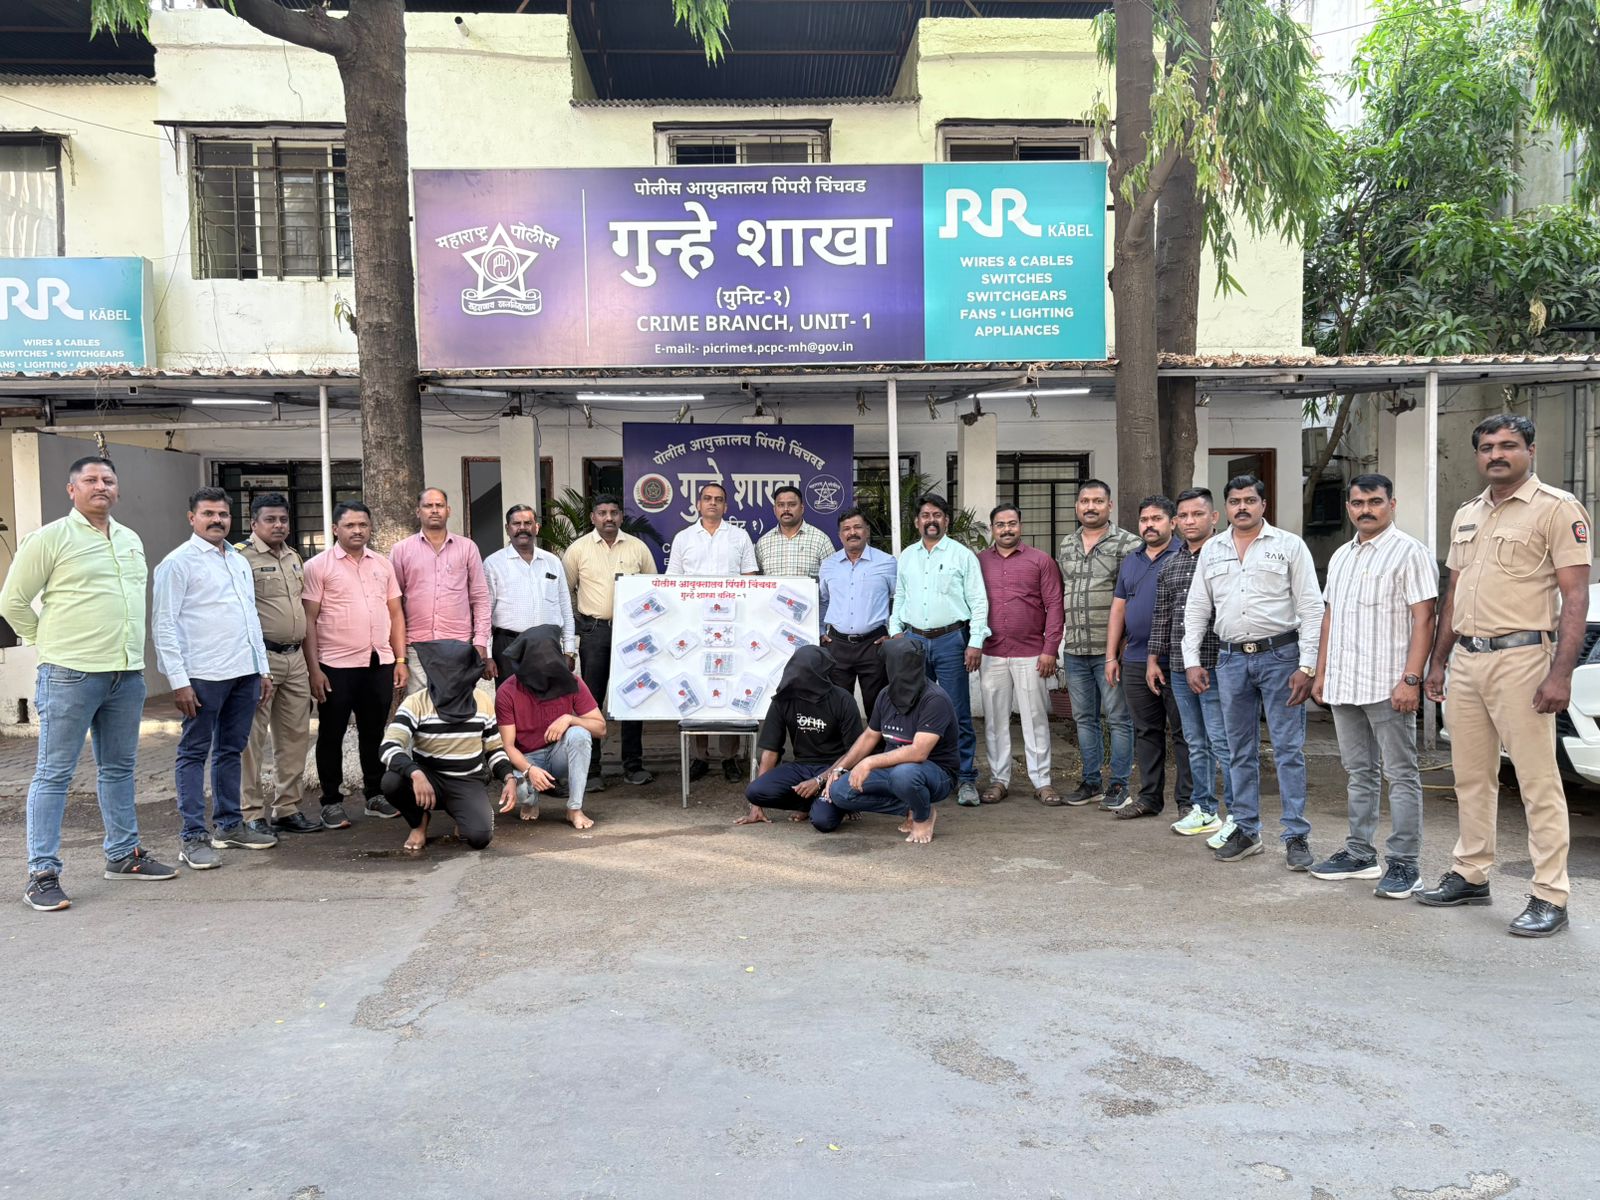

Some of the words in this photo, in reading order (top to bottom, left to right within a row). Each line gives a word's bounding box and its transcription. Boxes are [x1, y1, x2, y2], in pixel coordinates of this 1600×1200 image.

[634, 178, 682, 197] पोलीस
[686, 178, 767, 200] आयुक्तालय
[772, 176, 812, 195] पिंपरी
[816, 176, 866, 194] चिंचवड
[939, 188, 1042, 239] RR
[435, 225, 489, 249] महाराष्ट्र
[509, 221, 560, 250] पोलीस
[609, 201, 717, 287] गुन्हे
[736, 218, 893, 268] शाखा
[960, 256, 1005, 268] WIRES
[1008, 257, 1017, 267] &
[1021, 255, 1073, 267] CABLES
[981, 273, 1053, 285] SWITCHES
[716, 286, 791, 311] (युनिट-१)
[967, 290, 1068, 302] SWITCHGEARS
[960, 308, 997, 320] FANS
[1010, 307, 1073, 319] LIGHTING
[637, 314, 700, 333] CRIME
[706, 313, 794, 334] BRANCH,
[800, 312, 857, 331] UNIT-
[861, 312, 872, 330] 1
[974, 324, 1060, 337] APPLIANCES
[23, 338, 53, 347] WIRES
[55, 339, 61, 347] &
[63, 339, 100, 347] CABLES
[703, 341, 854, 357] picrime1.pcpc-mh@gov.in
[0, 350, 48, 358] SWITCHES
[56, 350, 125, 358] SWITCHGEARS
[0, 361, 16, 369] ANS
[24, 361, 67, 369] LIGHTING
[653, 443, 687, 466] पोलीस
[690, 434, 752, 453] आयुक्तालय
[756, 431, 785, 453] पिंपरी
[789, 440, 826, 471] चिंचवड
[1264, 551, 1285, 561] RAW
